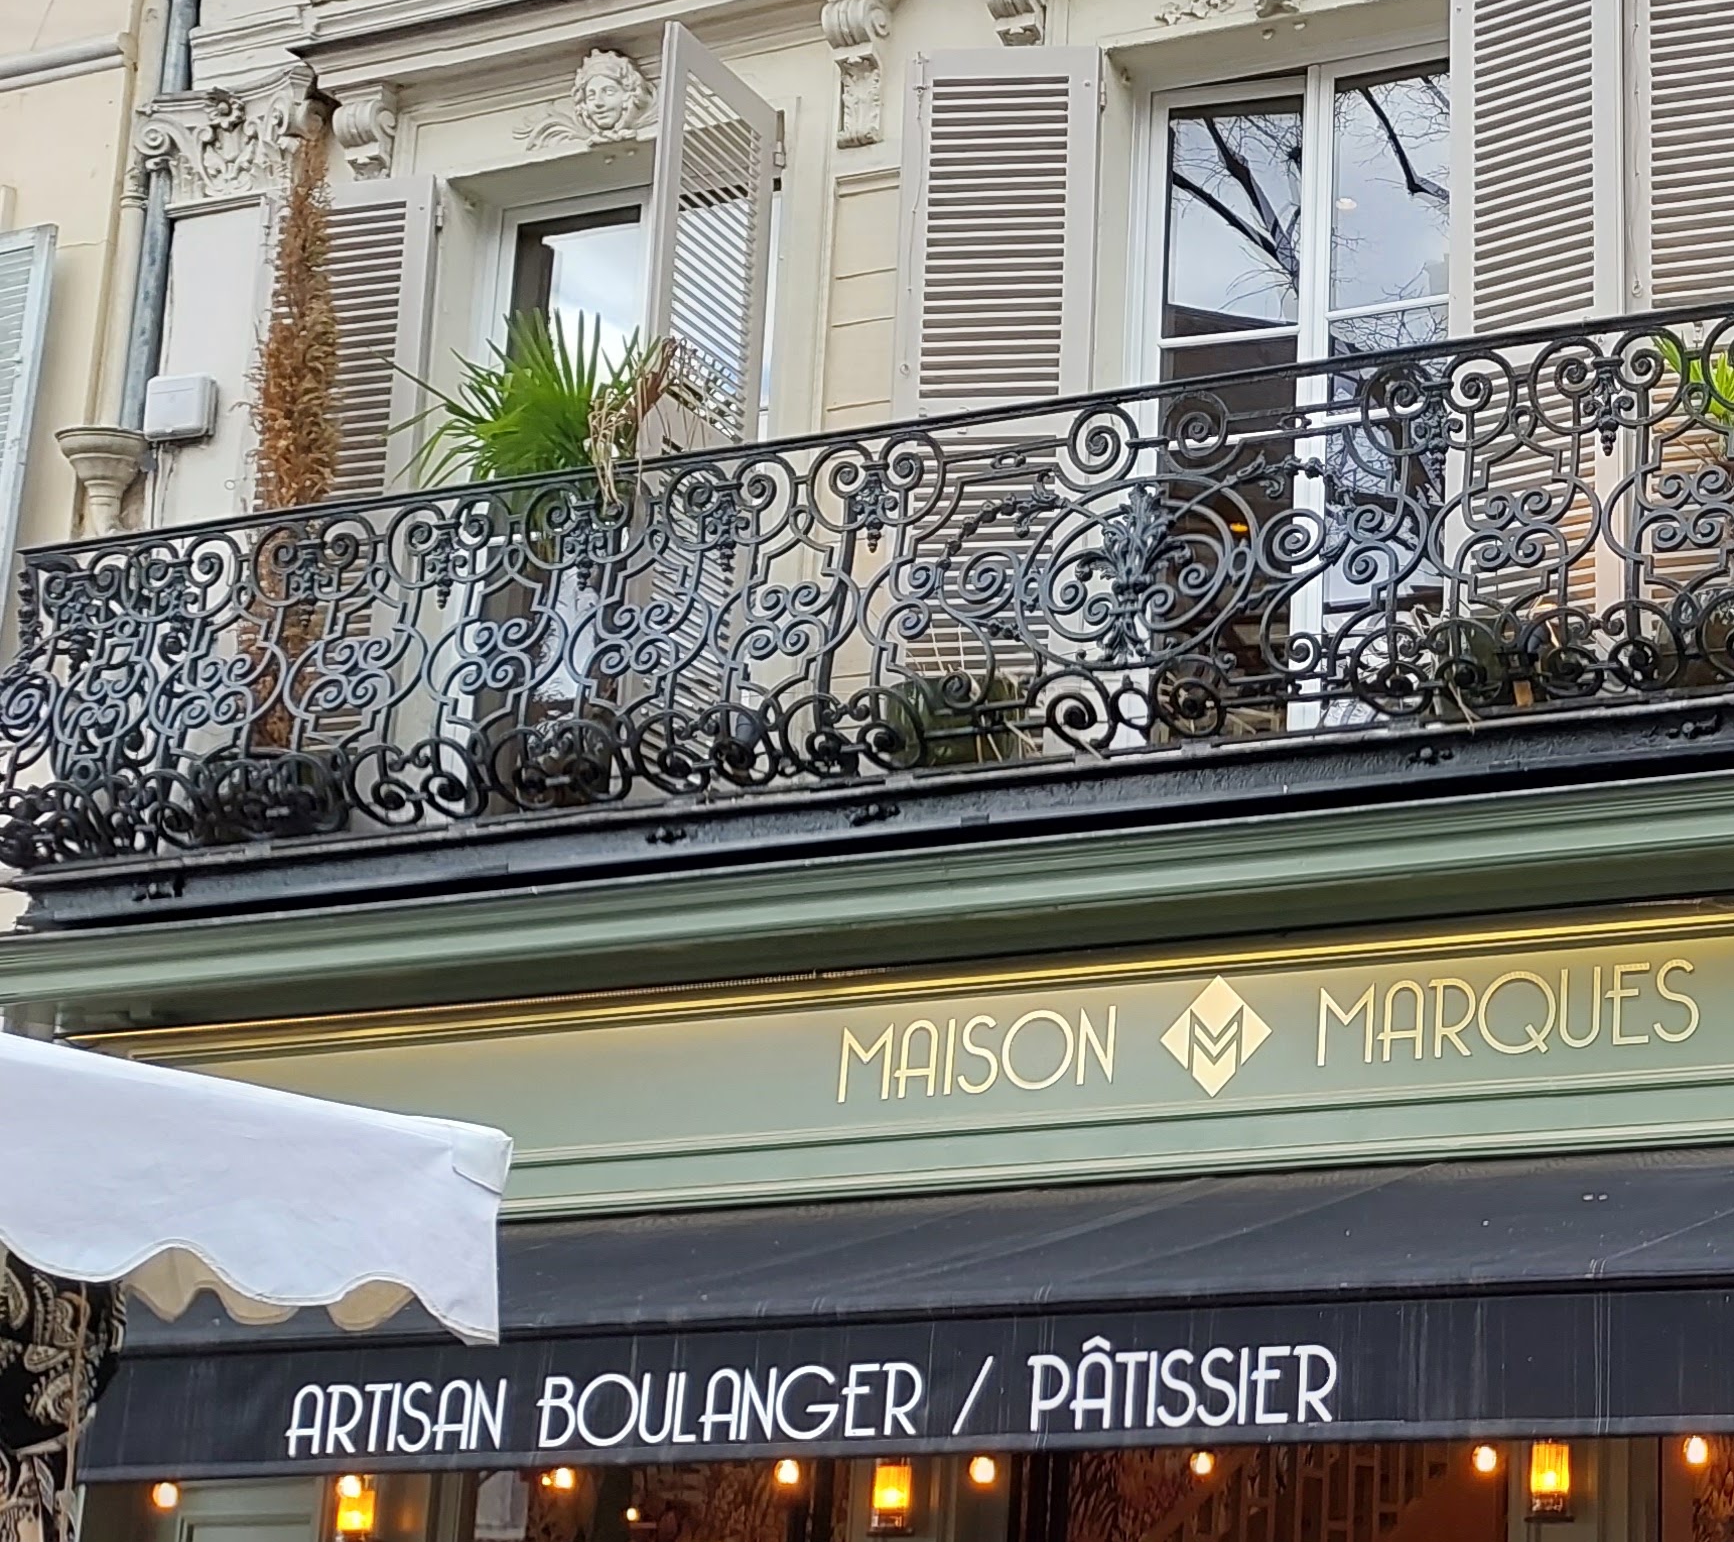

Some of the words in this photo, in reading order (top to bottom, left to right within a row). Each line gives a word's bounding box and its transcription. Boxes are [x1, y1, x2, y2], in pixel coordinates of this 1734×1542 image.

[837, 1004, 1117, 1104] MAISON
[1317, 958, 1700, 1067] MARQUES
[285, 1377, 507, 1458] ARTISAN
[536, 1362, 923, 1450] BOULANGER
[1027, 1335, 1338, 1432] PÂTISSIER
